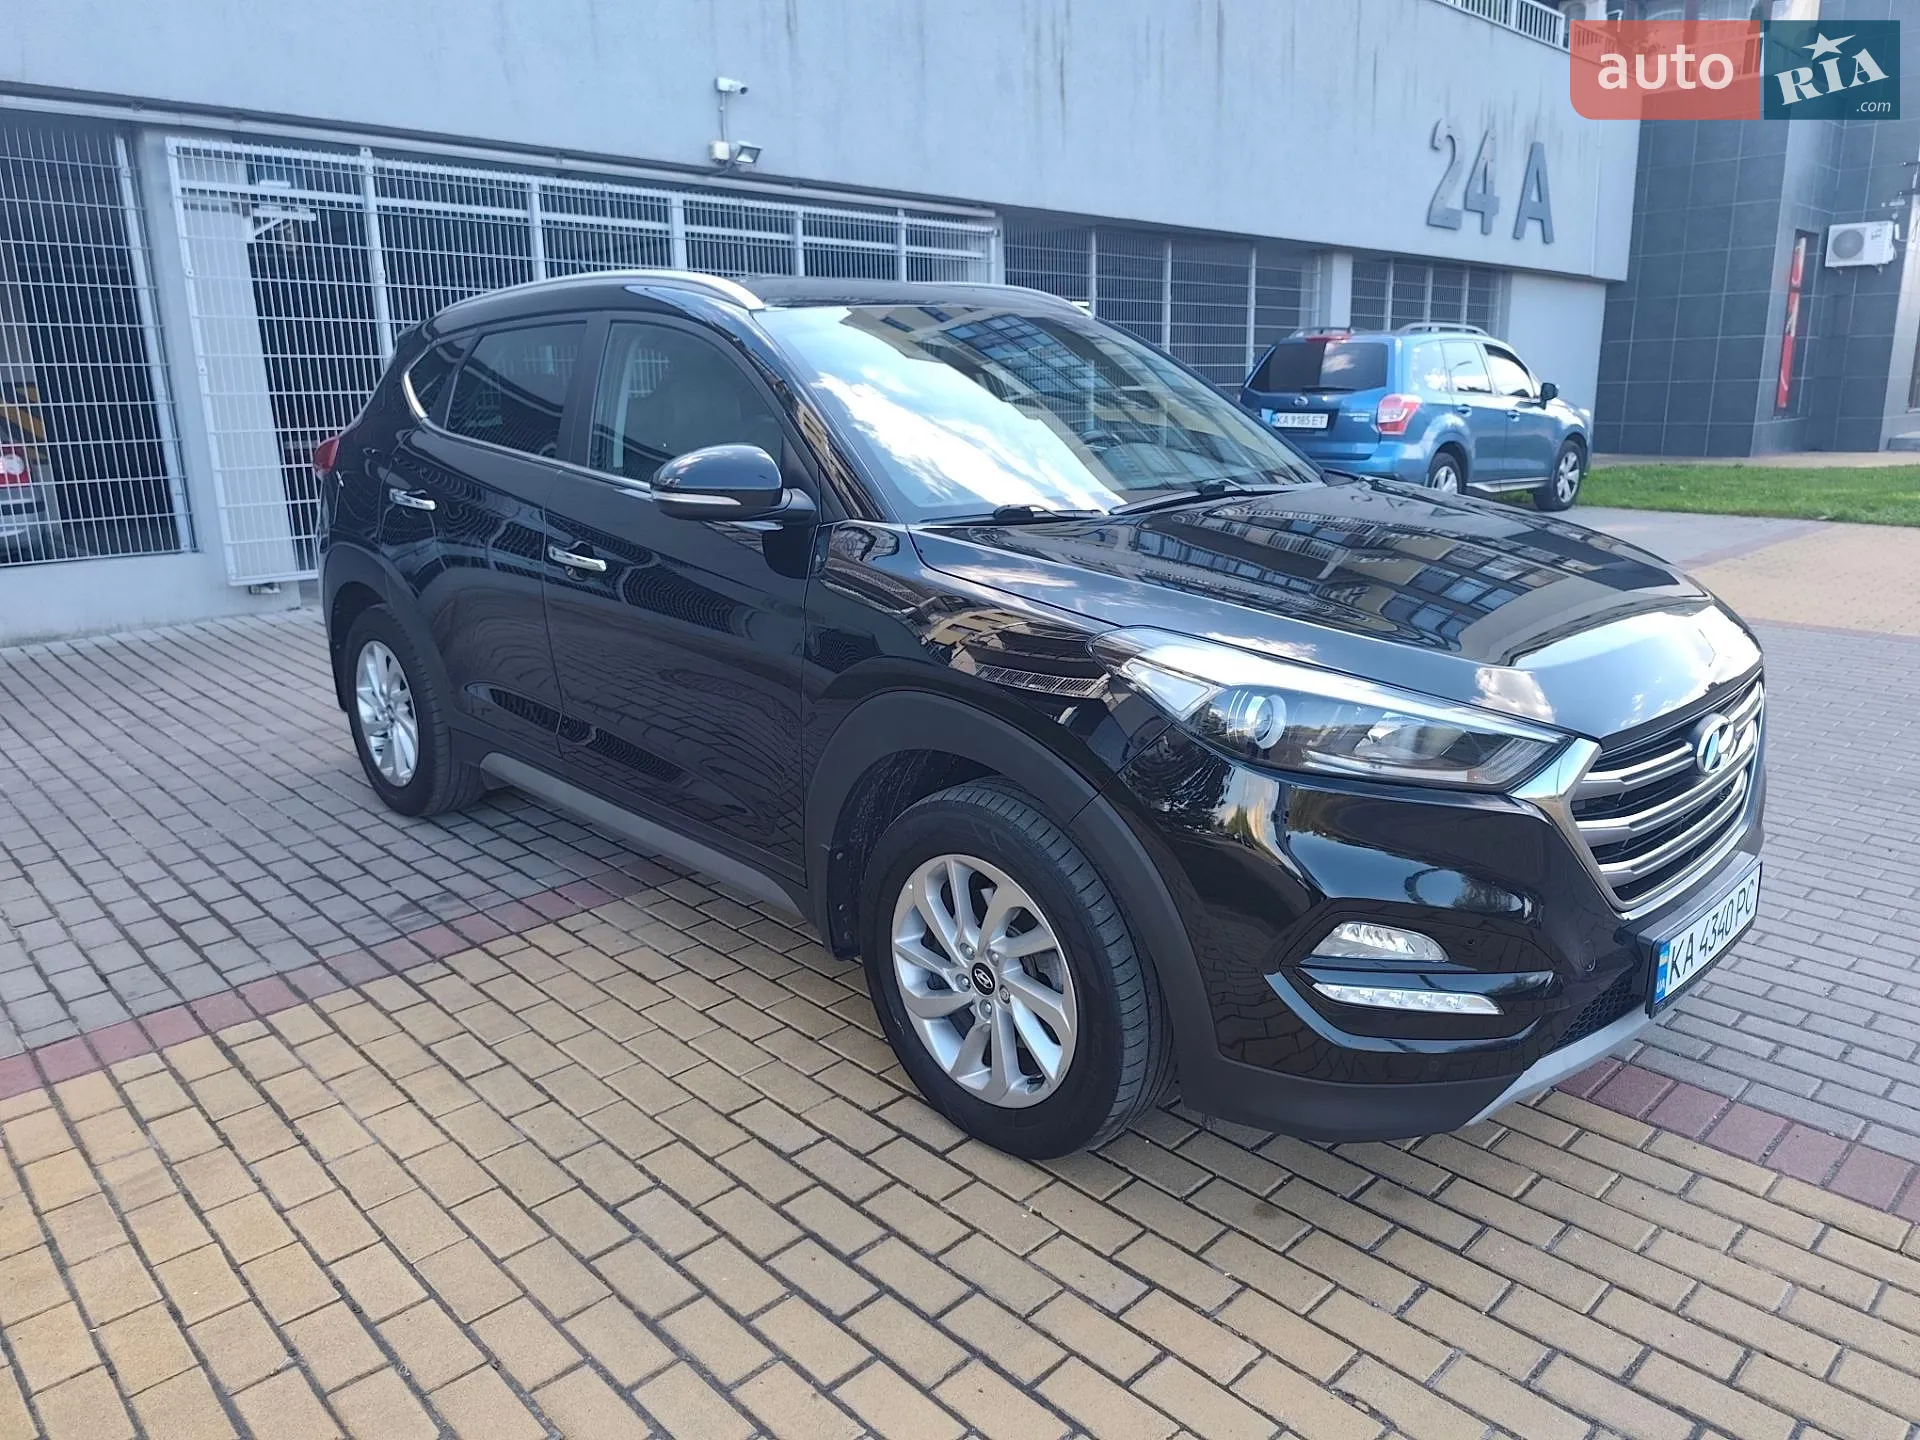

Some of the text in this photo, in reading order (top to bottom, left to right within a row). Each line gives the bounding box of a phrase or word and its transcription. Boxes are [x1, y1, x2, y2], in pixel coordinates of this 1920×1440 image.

[1426, 118, 1554, 244] 24 A
[1276, 415, 1289, 425] KA
[1669, 878, 1755, 985] KA 4340 PC
